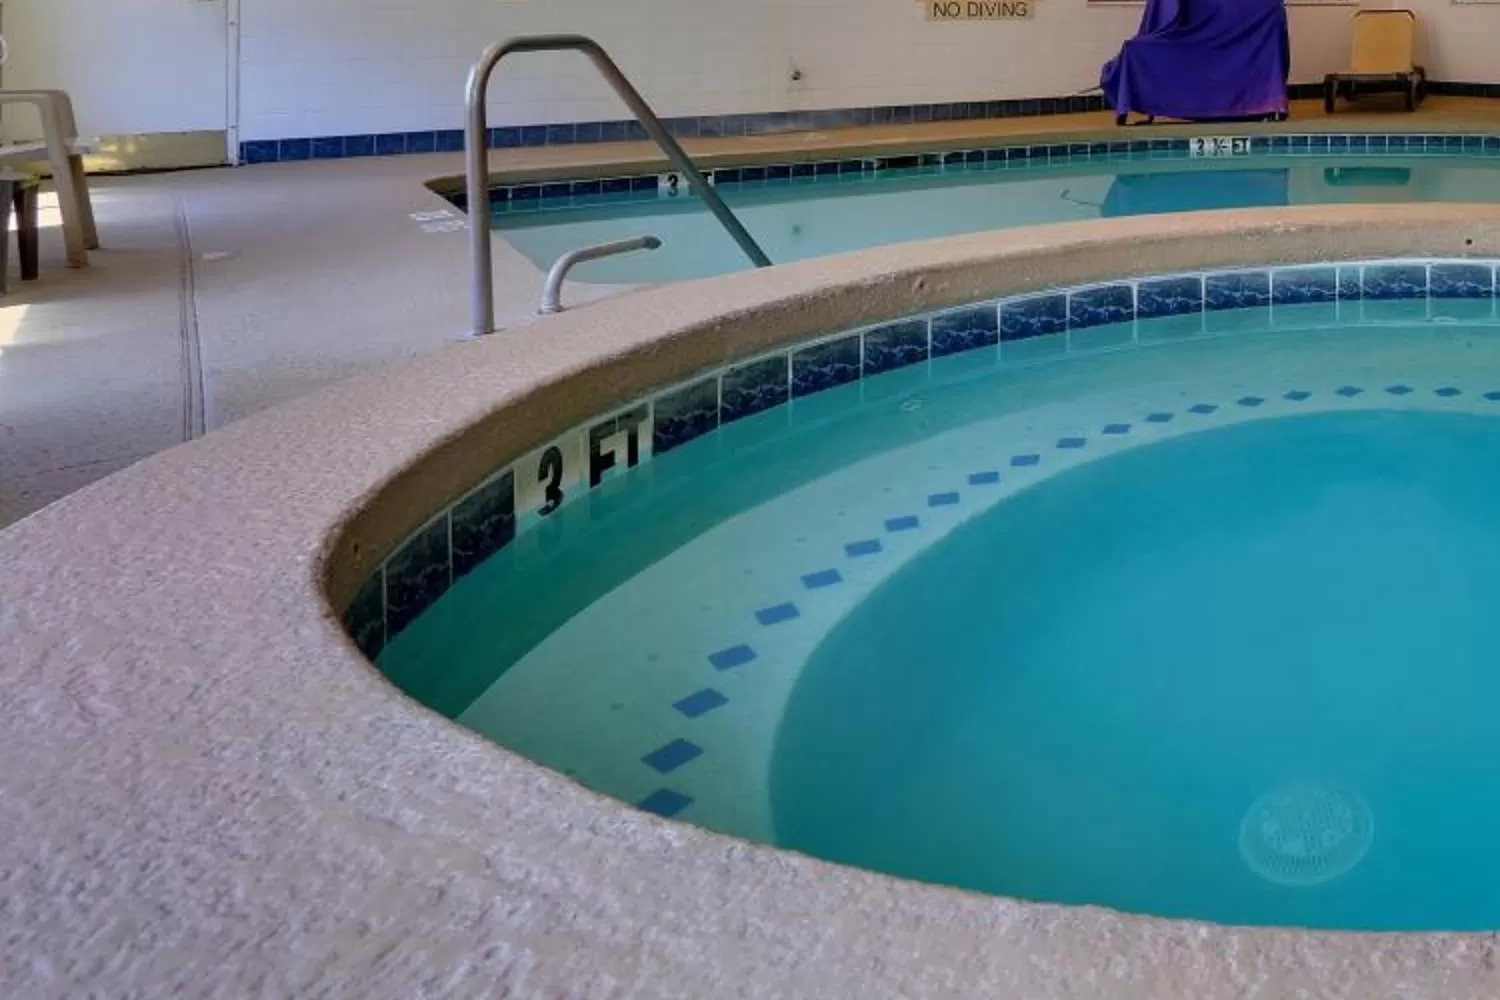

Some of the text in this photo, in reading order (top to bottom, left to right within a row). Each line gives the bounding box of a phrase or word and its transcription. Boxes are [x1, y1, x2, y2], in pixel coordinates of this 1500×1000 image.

[933, 1, 1028, 17] NO DIVING
[537, 406, 650, 518] 3 FT
